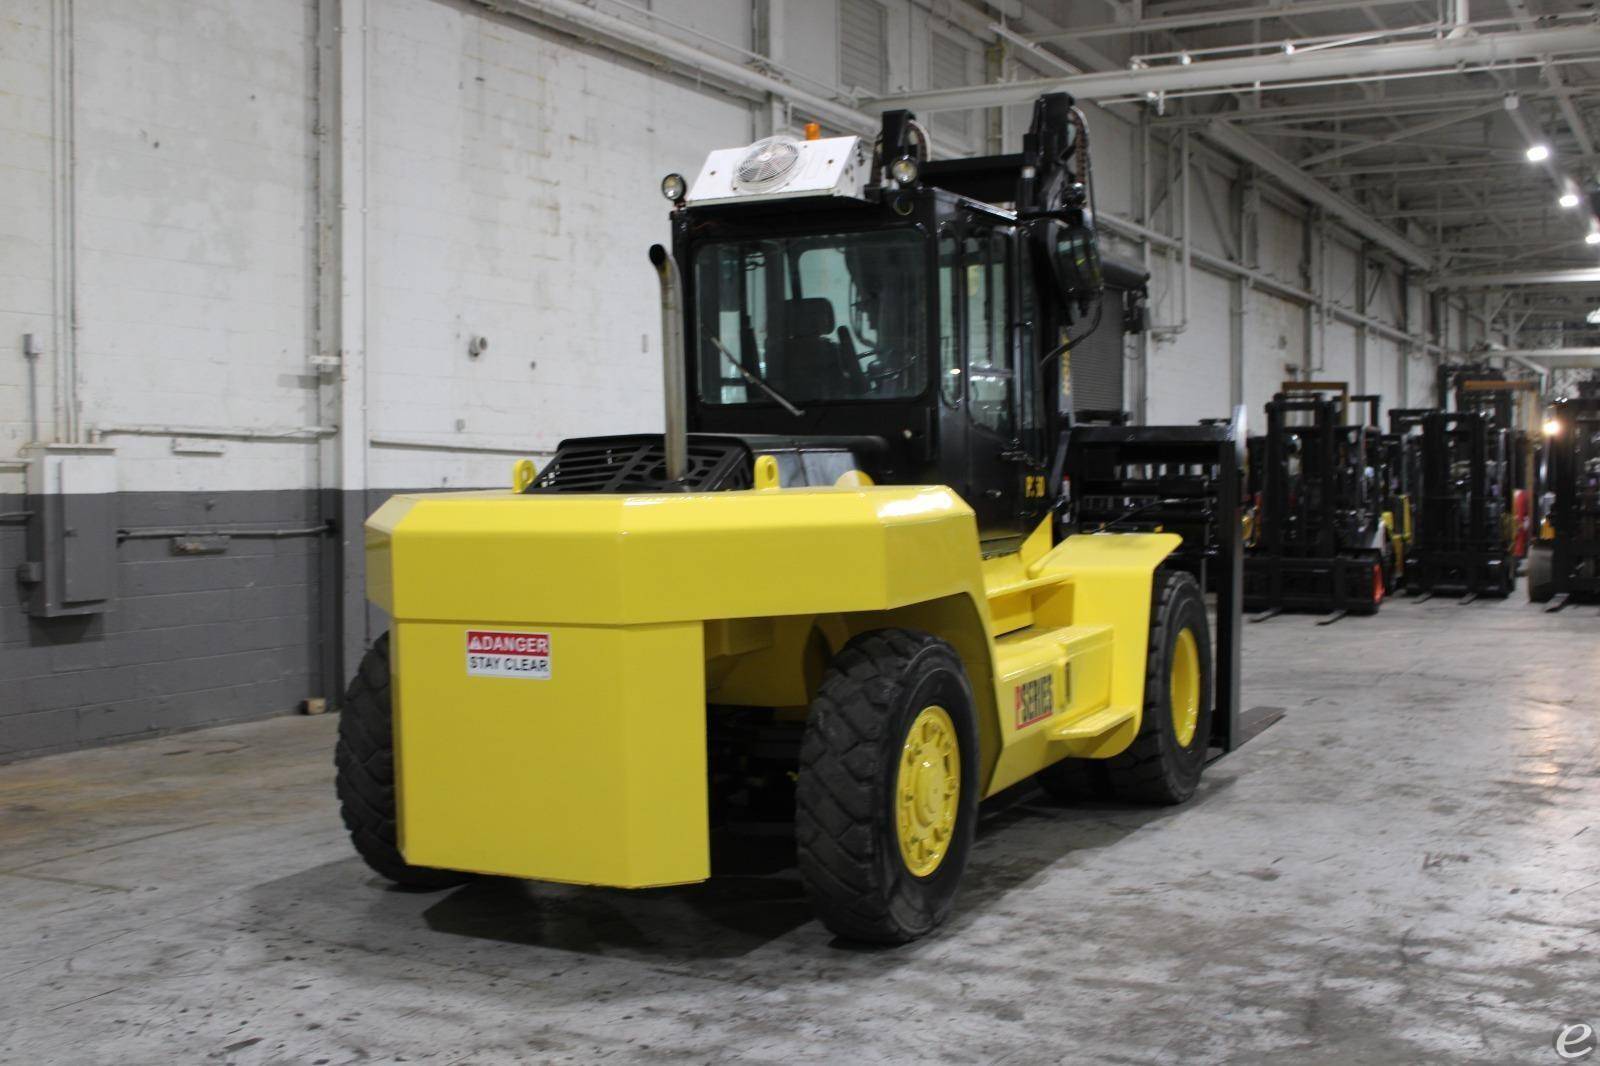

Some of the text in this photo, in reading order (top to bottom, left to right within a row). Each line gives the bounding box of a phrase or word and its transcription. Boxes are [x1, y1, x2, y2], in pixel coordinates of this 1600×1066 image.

[481, 635, 549, 653] DANGER
[470, 656, 549, 672] STAY CLEAR
